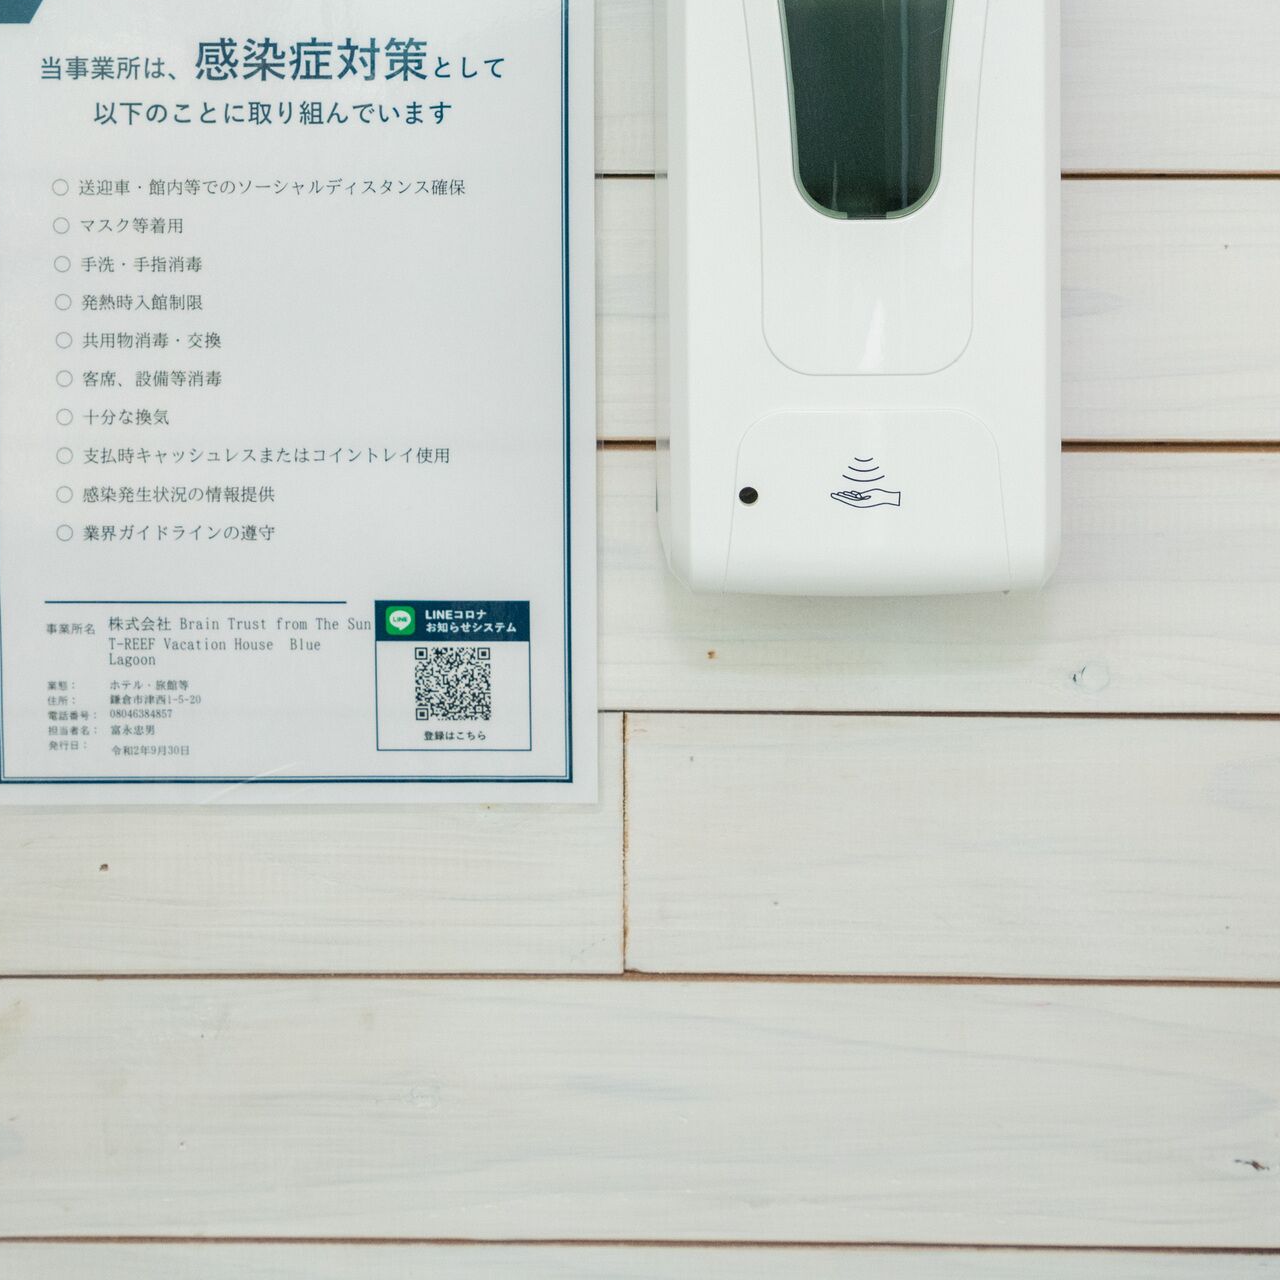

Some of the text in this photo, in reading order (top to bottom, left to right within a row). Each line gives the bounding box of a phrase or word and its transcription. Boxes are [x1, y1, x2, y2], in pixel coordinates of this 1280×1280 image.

[40, 37, 506, 82] 当事業所は、感染症対策として
[94, 101, 453, 125] 以下のことに取り組んでいます
[79, 178, 466, 197] 送迎車・館内等でのソーシャルディスタンス確保
[80, 217, 184, 234] マスク等着用
[81, 255, 203, 273] 手洗・手指消毒
[81, 293, 203, 311] 発熱時入館制限
[82, 331, 222, 349] 共用物消毒・交換
[82, 370, 222, 388] 客席、設備等消毒
[82, 408, 170, 426] 十分な換気
[82, 447, 451, 465] 支払時キャッシュレスまたはコイントレイ使用
[82, 485, 275, 503] 感染発生状況の情報提供
[83, 524, 276, 542] 業界ガイドラインの遵守
[425, 609, 487, 620] LINEコロナ
[46, 616, 372, 635] 事業所名 株式会社 Brain Trust from The Sun
[426, 622, 517, 633] お知らせシステム
[109, 637, 321, 651] T-REEF Vacation House Blue
[109, 653, 156, 667] Lagoon
[110, 709, 172, 718] 08046384857
[424, 731, 486, 741] 登録はこちら
[112, 745, 190, 756] 令和2年9月30日
